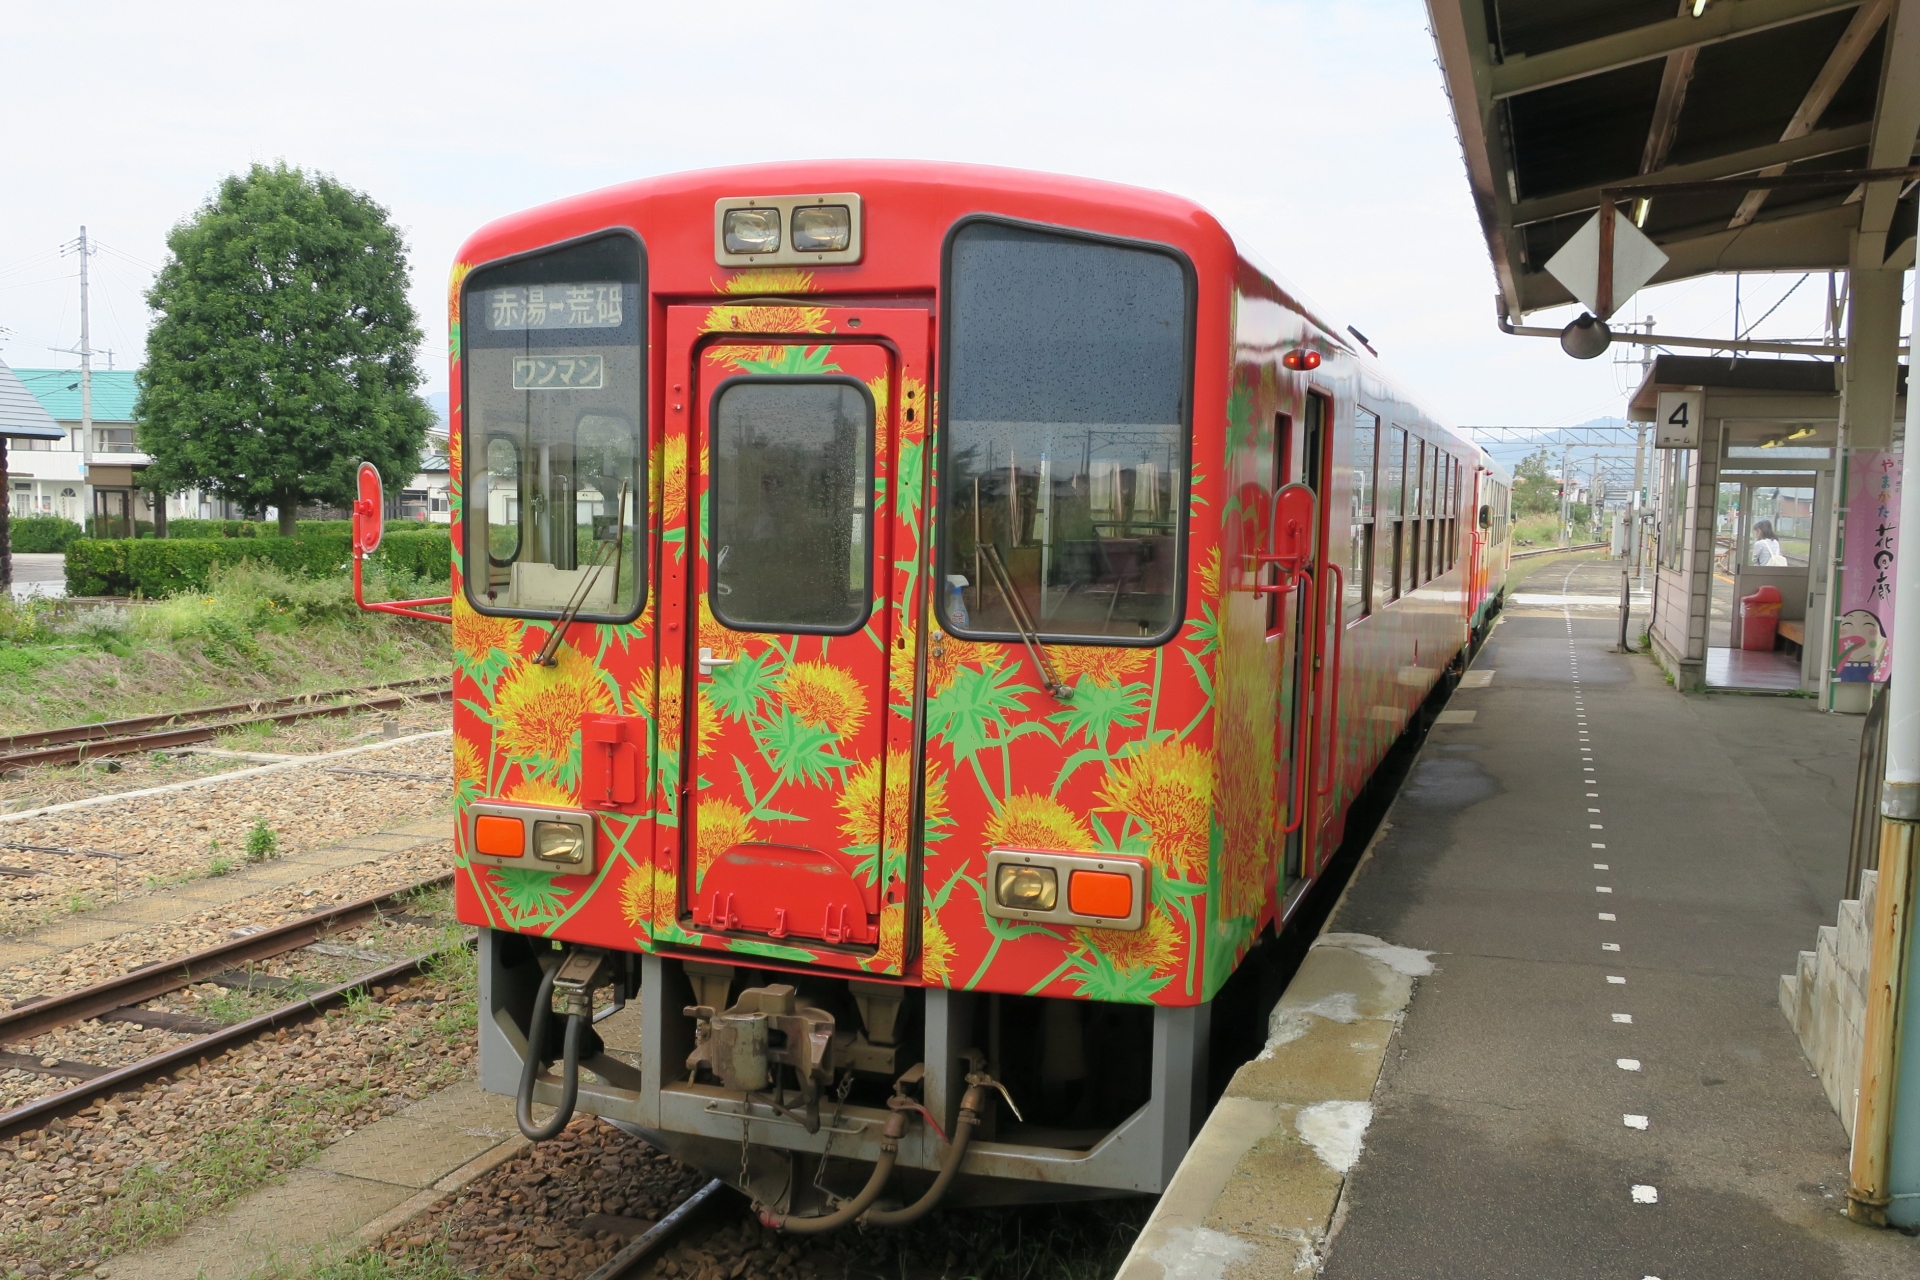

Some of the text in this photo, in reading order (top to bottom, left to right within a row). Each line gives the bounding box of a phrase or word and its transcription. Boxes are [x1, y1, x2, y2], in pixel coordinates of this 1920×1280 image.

[516, 359, 600, 385] ワンマン
[1668, 402, 1689, 428] 4
[1663, 436, 1691, 444] ホーム
